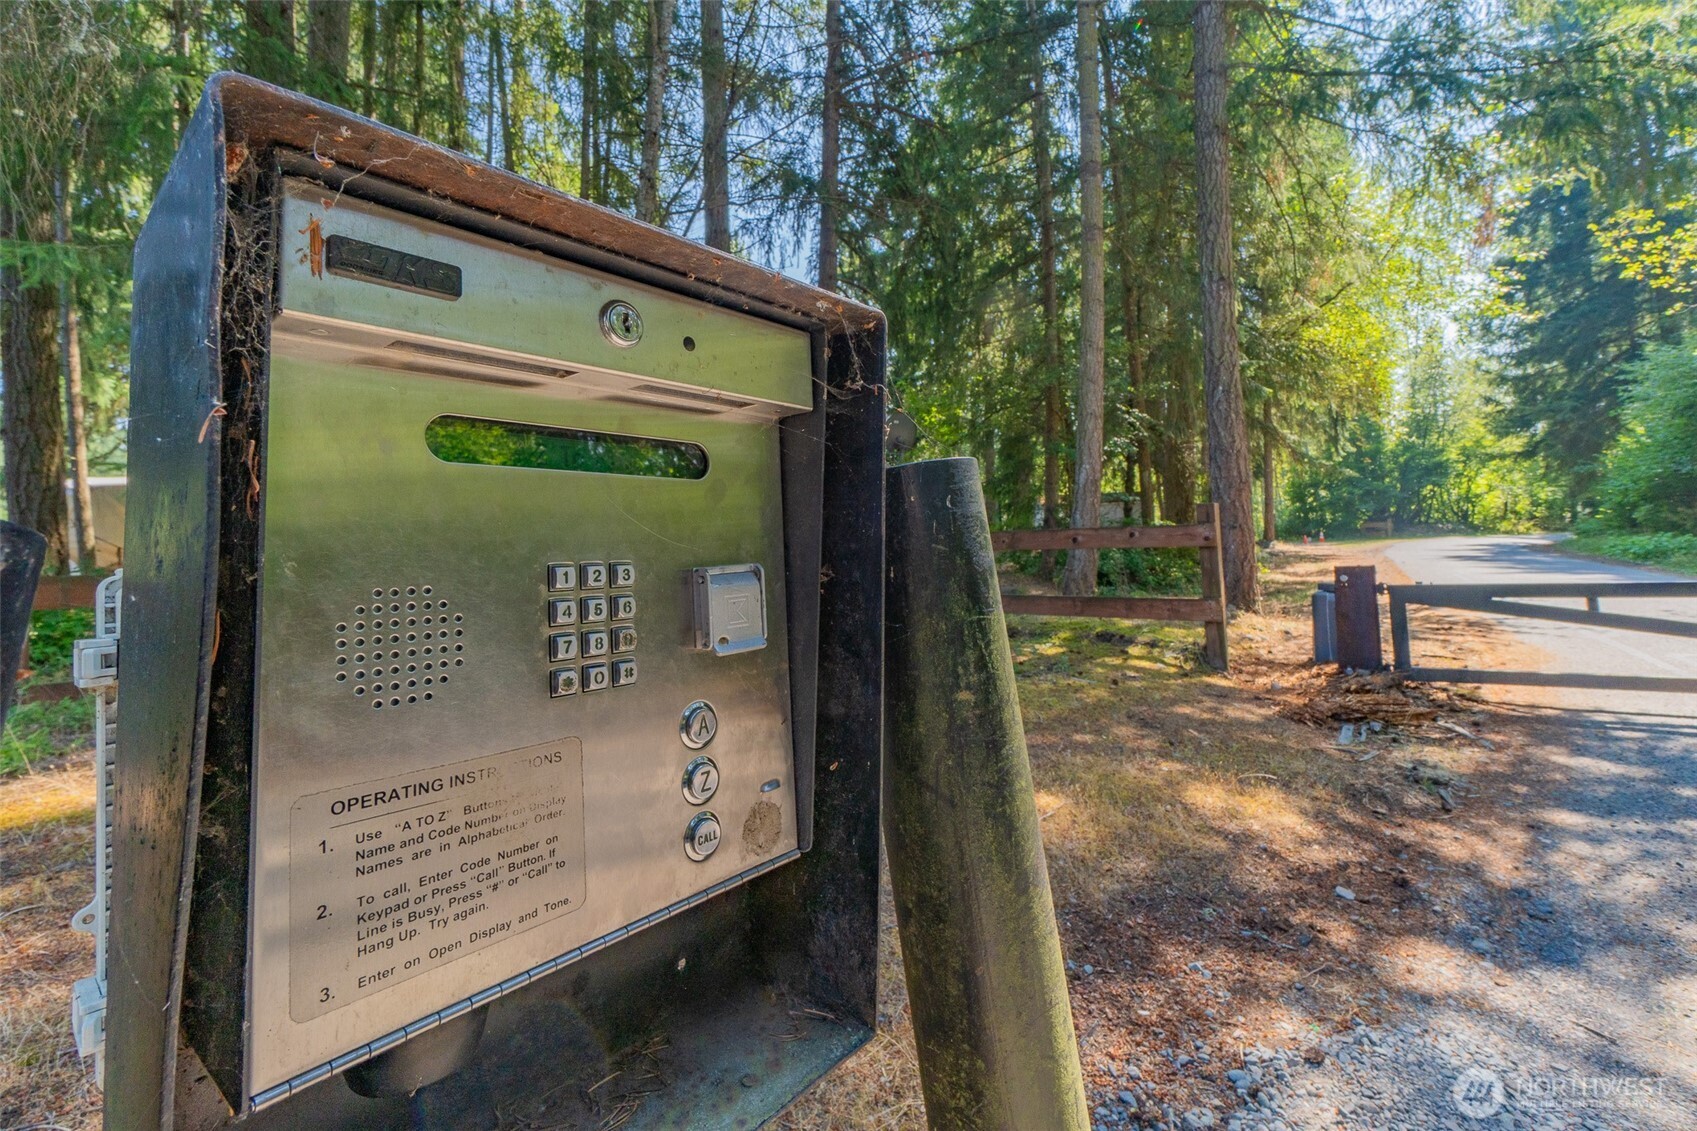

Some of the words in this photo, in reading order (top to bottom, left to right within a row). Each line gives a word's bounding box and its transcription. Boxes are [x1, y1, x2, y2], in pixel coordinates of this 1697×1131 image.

[563, 571, 569, 584] 1
[593, 569, 602, 582] 2
[622, 568, 631, 581] 3
[562, 605, 572, 618] 4
[594, 603, 603, 616] 5
[623, 600, 632, 614] 6
[563, 640, 573, 654] 7
[595, 637, 604, 650] 8
[594, 671, 605, 685] 0
[624, 666, 634, 679] #
[699, 714, 709, 737] A
[330, 778, 444, 816] OPERATING
[450, 750, 562, 789] INSTRIONS
[700, 770, 712, 793] Z
[319, 840, 334, 854] 1.
[355, 829, 382, 844] Use
[415, 814, 434, 828] TO
[356, 844, 395, 862] Name
[400, 834, 424, 849] and
[428, 824, 460, 841] Code
[356, 856, 404, 878] Names
[411, 848, 432, 861] are
[440, 841, 451, 853] in
[534, 808, 566, 824] Order.
[697, 829, 718, 847] CALL
[316, 904, 332, 920] 2.
[357, 894, 374, 908] To
[383, 883, 411, 899] call,
[419, 869, 453, 888] Enter
[460, 856, 490, 874] Code
[498, 840, 540, 862] Number
[546, 834, 558, 846] on
[356, 900, 410, 925] Keypad
[414, 893, 428, 906] or
[432, 880, 466, 899] Press
[508, 854, 546, 874] Button.
[549, 848, 556, 859] If
[357, 923, 388, 941] Line
[392, 916, 404, 929] is
[408, 904, 445, 924] Busy,
[449, 890, 482, 909] Press
[508, 875, 520, 888] or
[556, 859, 566, 870] to
[320, 987, 335, 1003] 3.
[358, 966, 396, 989] Enter
[404, 956, 420, 970] on
[428, 940, 462, 960] Open
[469, 919, 512, 944] Display
[518, 908, 538, 924] and
[544, 895, 572, 914] Tone.
[357, 938, 394, 958] Hang
[399, 925, 420, 943] Up.
[429, 914, 448, 932] Try
[453, 903, 489, 923] again.
